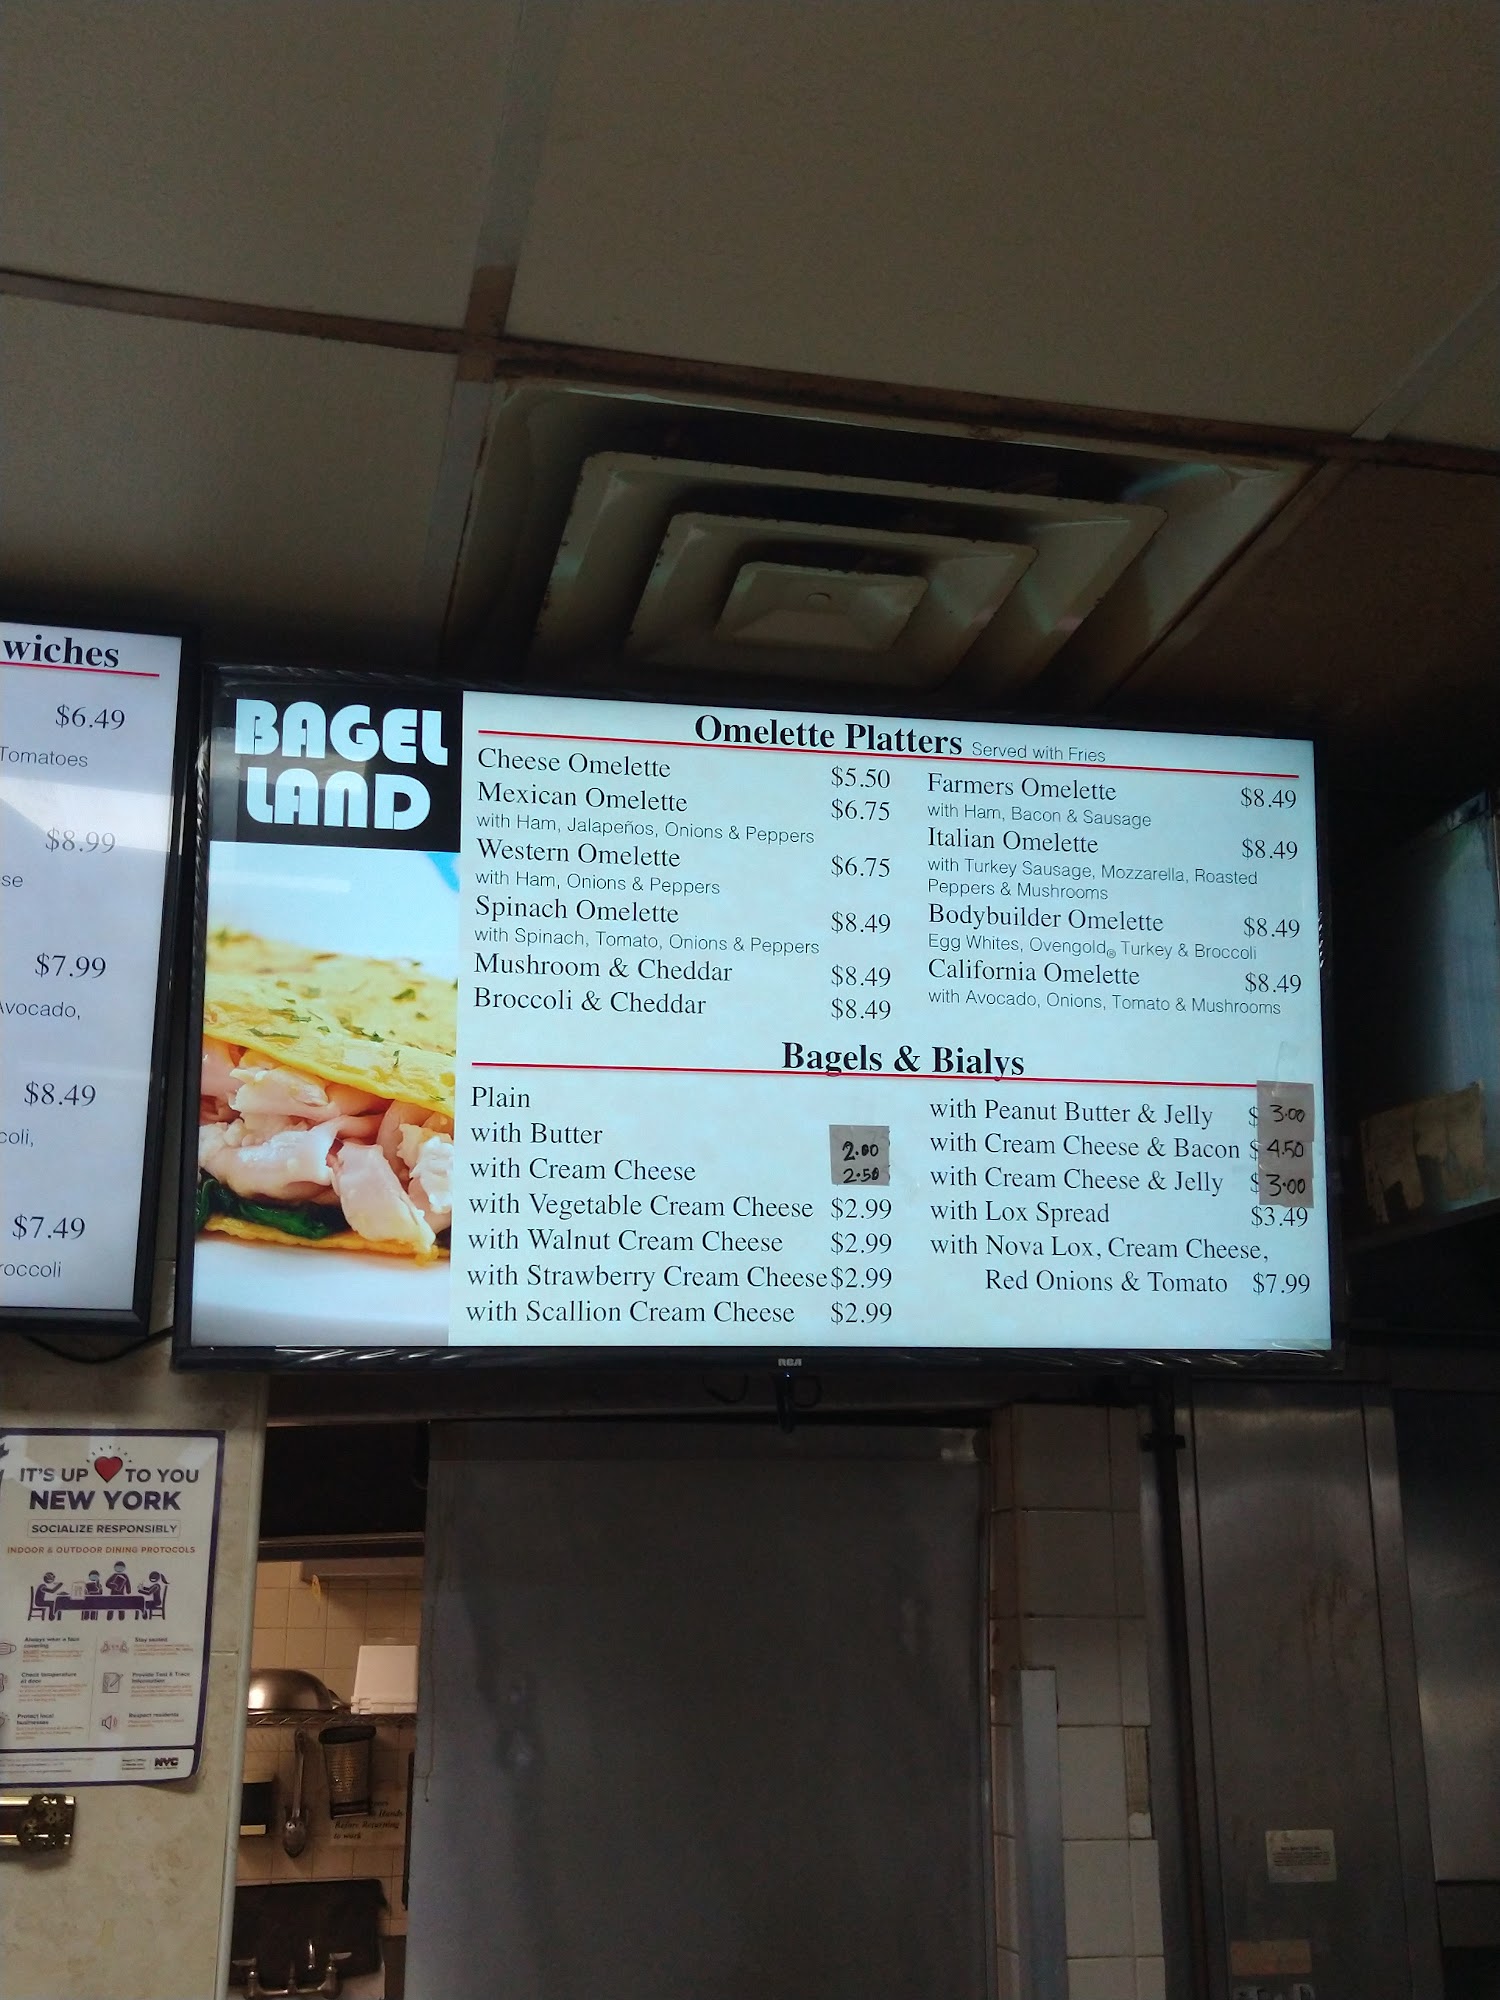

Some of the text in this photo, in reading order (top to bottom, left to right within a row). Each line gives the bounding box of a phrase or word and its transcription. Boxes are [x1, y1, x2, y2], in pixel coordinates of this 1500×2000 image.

[56, 704, 125, 730] $6.49
[235, 698, 449, 766] BAGEL
[694, 714, 1106, 763] Omelette Platters Served with Fries
[477, 747, 671, 778] Cheese Omelette
[831, 765, 891, 789] $5.50
[927, 772, 1117, 801] Farmers Omelette
[246, 767, 431, 831] LAND
[476, 780, 688, 812] Mexican Omelette
[830, 797, 890, 821] $6.75
[1240, 786, 1297, 809] $8.49
[927, 802, 1152, 830] with Ham, Bacon & Sausage
[45, 828, 116, 853] $8.99
[475, 813, 815, 846] with Ham, Jalapeños, Onions & Peppers
[927, 826, 1099, 854] Italian Omelette
[475, 837, 681, 868] Western Omelette
[1241, 837, 1298, 861] $8.49
[830, 854, 891, 878] $6.75
[927, 857, 1258, 885] with Turkey Sausage, Mozzarella, Roasted
[928, 878, 1109, 900] Peppers & Mushrooms
[475, 894, 680, 924] Spinach Omelette
[927, 902, 1165, 932] Bodybuilder Omelette
[830, 910, 891, 935] $8.49
[1243, 915, 1301, 939] $8.49
[474, 926, 820, 957] with Spinach, Tomato, Onions & Peppers
[928, 932, 961, 953] Egg
[965, 934, 1023, 953] Whites,
[1120, 940, 1173, 960] Turkey
[1177, 942, 1189, 958] &
[1194, 943, 1257, 960] Broccoli
[35, 952, 106, 978] $7.99
[473, 952, 733, 982] Mushroom & Cheddar
[831, 963, 891, 988] $8.49
[928, 958, 1141, 985] California Omelette
[1244, 971, 1302, 995] $8.49
[473, 986, 707, 1015] Broccoli & Cheddar
[830, 996, 891, 1021] $8.49
[928, 988, 1281, 1015] with Avocado, Onions, Tomato & Mushrooms
[781, 1041, 1025, 1081] Bagels & Bialys
[24, 1081, 96, 1106] $8.49
[470, 1086, 531, 1108] Plain
[929, 1097, 1214, 1131] with Peanut Butter & Jelly
[1269, 1104, 1305, 1123] 3.00
[470, 1121, 604, 1145] with Butter
[929, 1131, 978, 1153] with
[984, 1132, 1057, 1155] Cream
[1062, 1134, 1140, 1157] Cheese
[1146, 1136, 1167, 1157] &
[1173, 1137, 1241, 1159] Bacon
[842, 1141, 879, 1161] 2.00
[1266, 1139, 1304, 1159] 4.50
[842, 1167, 880, 1184] 2.50
[929, 1165, 1224, 1198] with Cream Cheese & Jelly
[1265, 1174, 1306, 1197] 3.00
[468, 1192, 814, 1221] with Vegetable Cream Cheese
[830, 1196, 892, 1222] $2.99
[929, 1199, 1110, 1229] with Lox Spread
[1251, 1206, 1308, 1228] $3.49
[12, 1214, 86, 1240] $7.49
[929, 1233, 1269, 1263] with Nova Lox, Cream Cheese,
[466, 1263, 828, 1293] with Strawberry Cream Cheese
[830, 1265, 892, 1291] $2.99
[984, 1268, 1228, 1293] Red Onions & Tomato
[1252, 1271, 1311, 1296] $7.99
[20, 1467, 200, 1484] IT'S UP TO YOU
[29, 1490, 182, 1511] NEW YORK
[31, 1524, 178, 1534] SOCIALIZE RESPONSIBLY
[7, 1546, 45, 1554] INDOOR
[56, 1546, 103, 1554] OUTDOOR
[105, 1546, 139, 1554] DINING
[141, 1546, 196, 1554] PROTOCOLS
